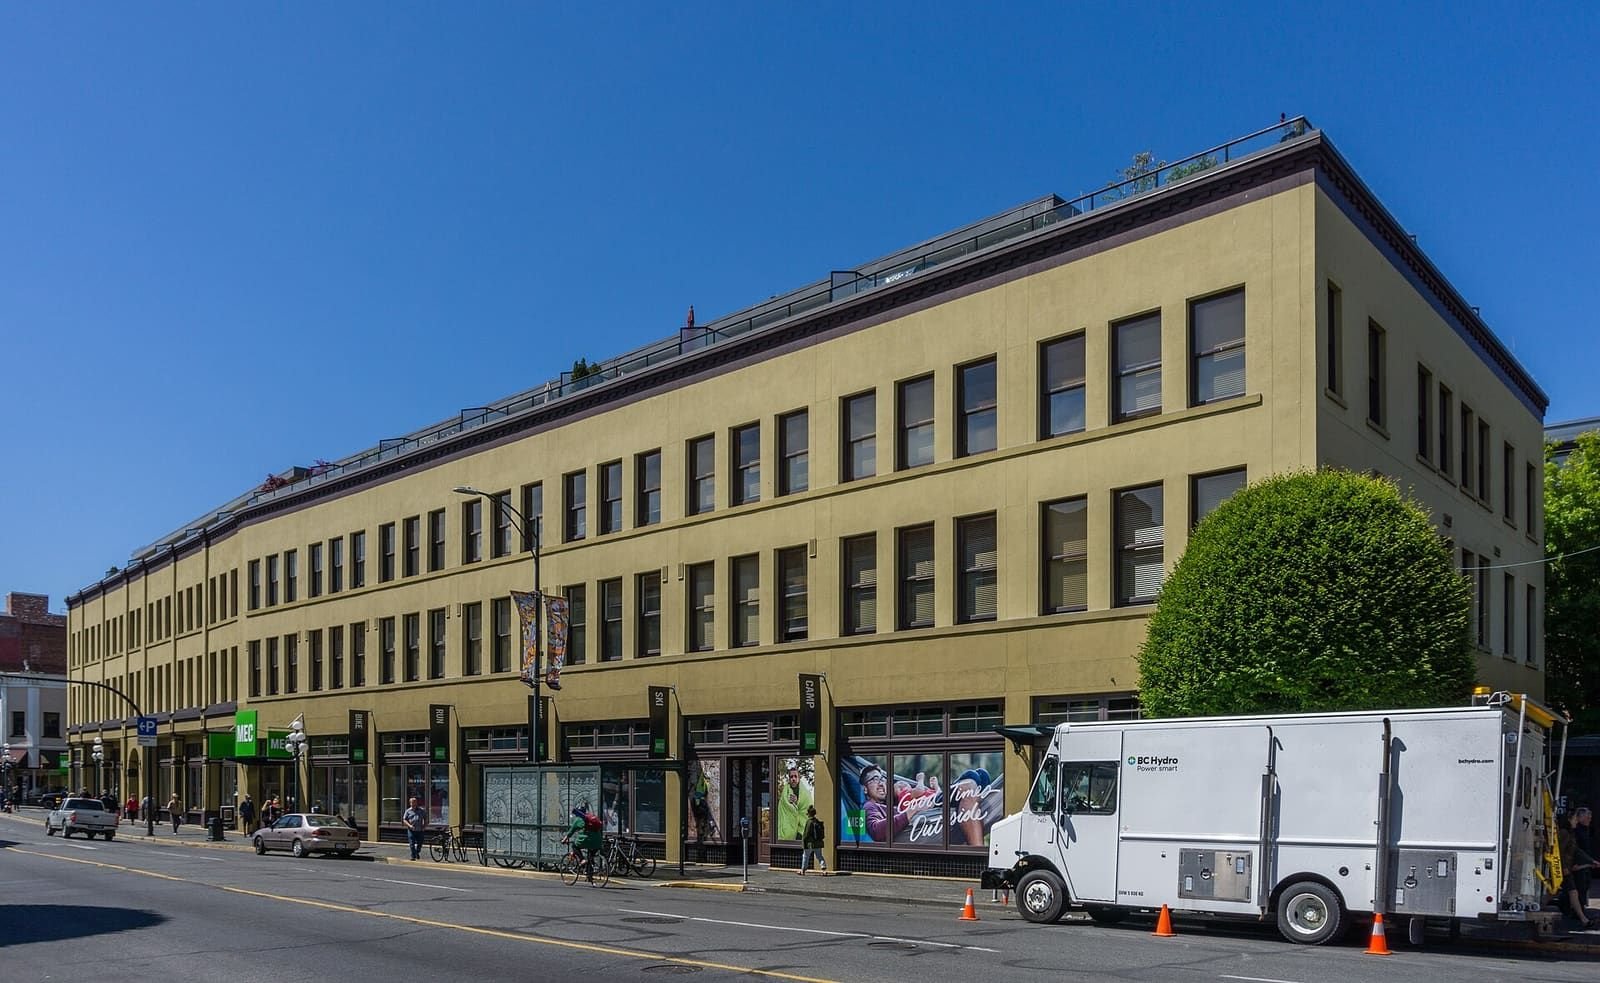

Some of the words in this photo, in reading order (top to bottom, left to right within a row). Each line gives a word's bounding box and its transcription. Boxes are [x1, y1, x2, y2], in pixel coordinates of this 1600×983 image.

[655, 691, 664, 706] SKI
[805, 680, 815, 709] CAMP
[354, 713, 364, 729] BIKE
[435, 708, 445, 724] RUN
[146, 720, 156, 733] P
[236, 724, 254, 743] MEC
[1137, 756, 1150, 765] BC
[1150, 756, 1179, 766] Hydro
[897, 791, 943, 814] Good
[949, 782, 1001, 802] Times
[847, 816, 864, 828] MEC
